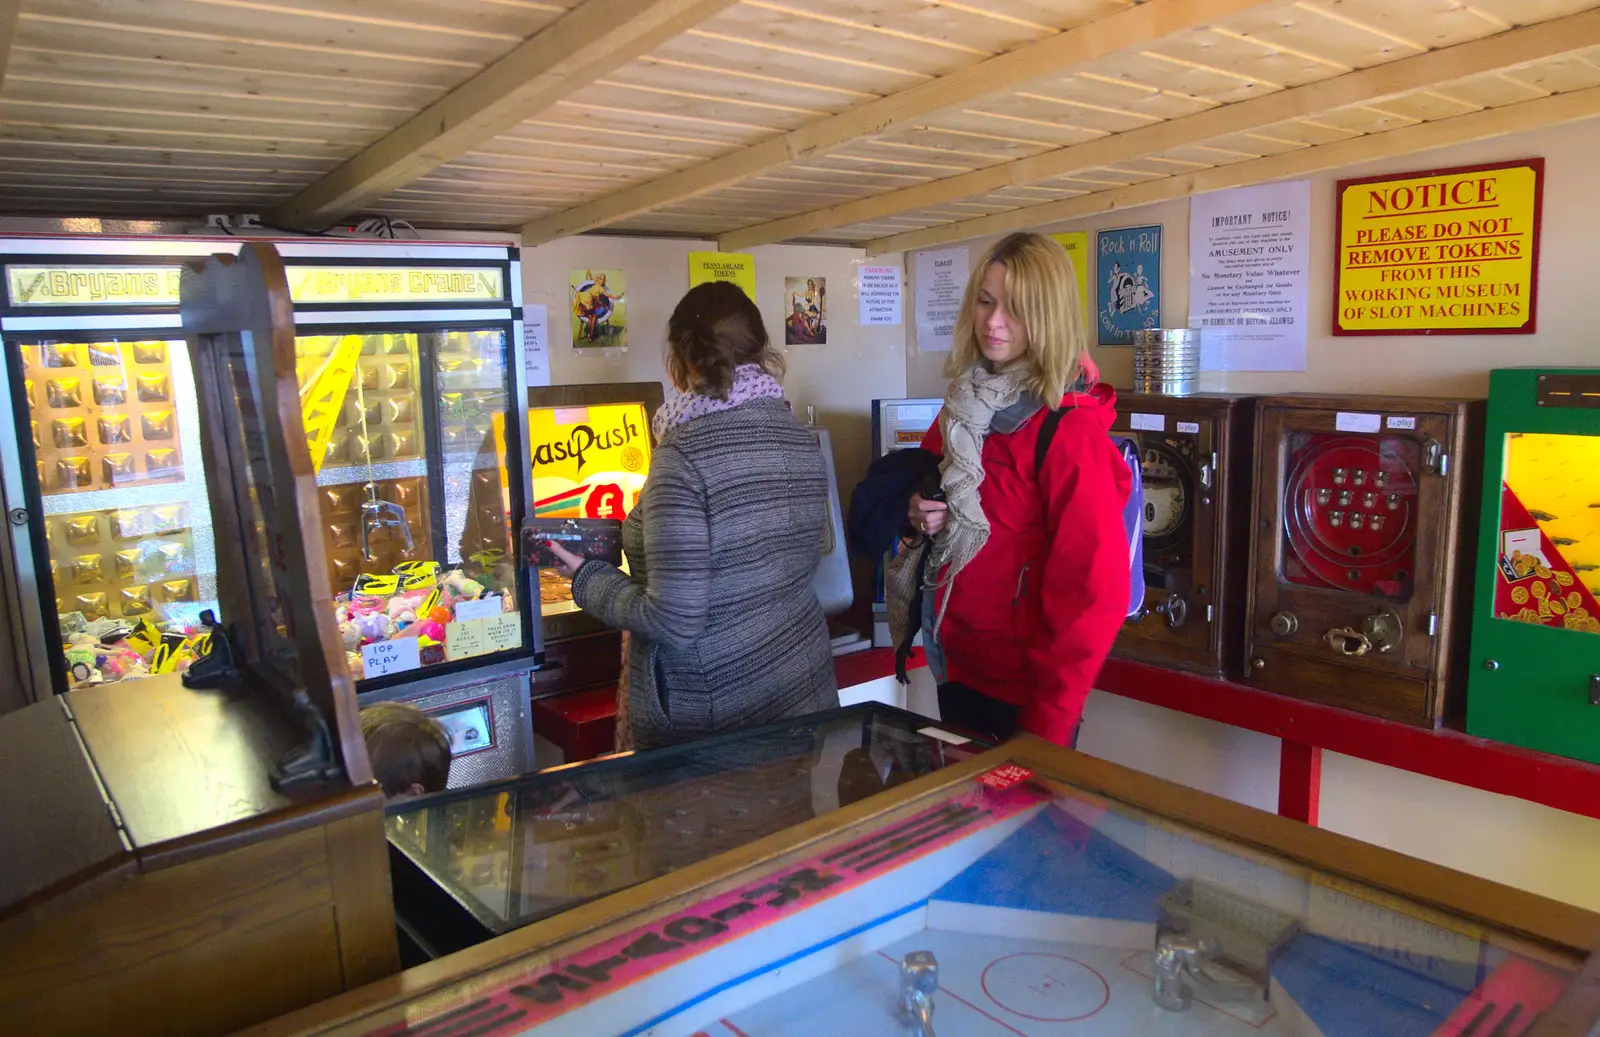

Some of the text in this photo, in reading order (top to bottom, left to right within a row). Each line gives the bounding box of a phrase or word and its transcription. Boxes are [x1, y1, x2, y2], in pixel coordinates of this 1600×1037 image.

[1368, 178, 1498, 213] NOTICE
[1212, 210, 1291, 227] IMPORTANT NOTICE!
[1356, 217, 1512, 244] PLEASE DO NOT
[1100, 236, 1125, 256] Rock
[1138, 232, 1158, 253] Roll
[1208, 244, 1294, 258] AMUSEMENT ONLY
[1348, 240, 1521, 266] REMOVE TOKENS
[1380, 264, 1481, 283] FROM THIS
[49, 270, 160, 301] Bryans
[317, 271, 475, 299] Bryans Crane
[1345, 283, 1521, 302] WORKING MUSEUM
[1343, 302, 1521, 320] OF SLOT MACHINES
[1099, 310, 1115, 334] Lost
[1202, 316, 1295, 326] NO GAMBLING OR BETTING ALLOWED
[1185, 423, 1197, 432] play
[1397, 419, 1412, 428] play
[532, 413, 639, 474] asyPush
[368, 655, 398, 668] PLAY
